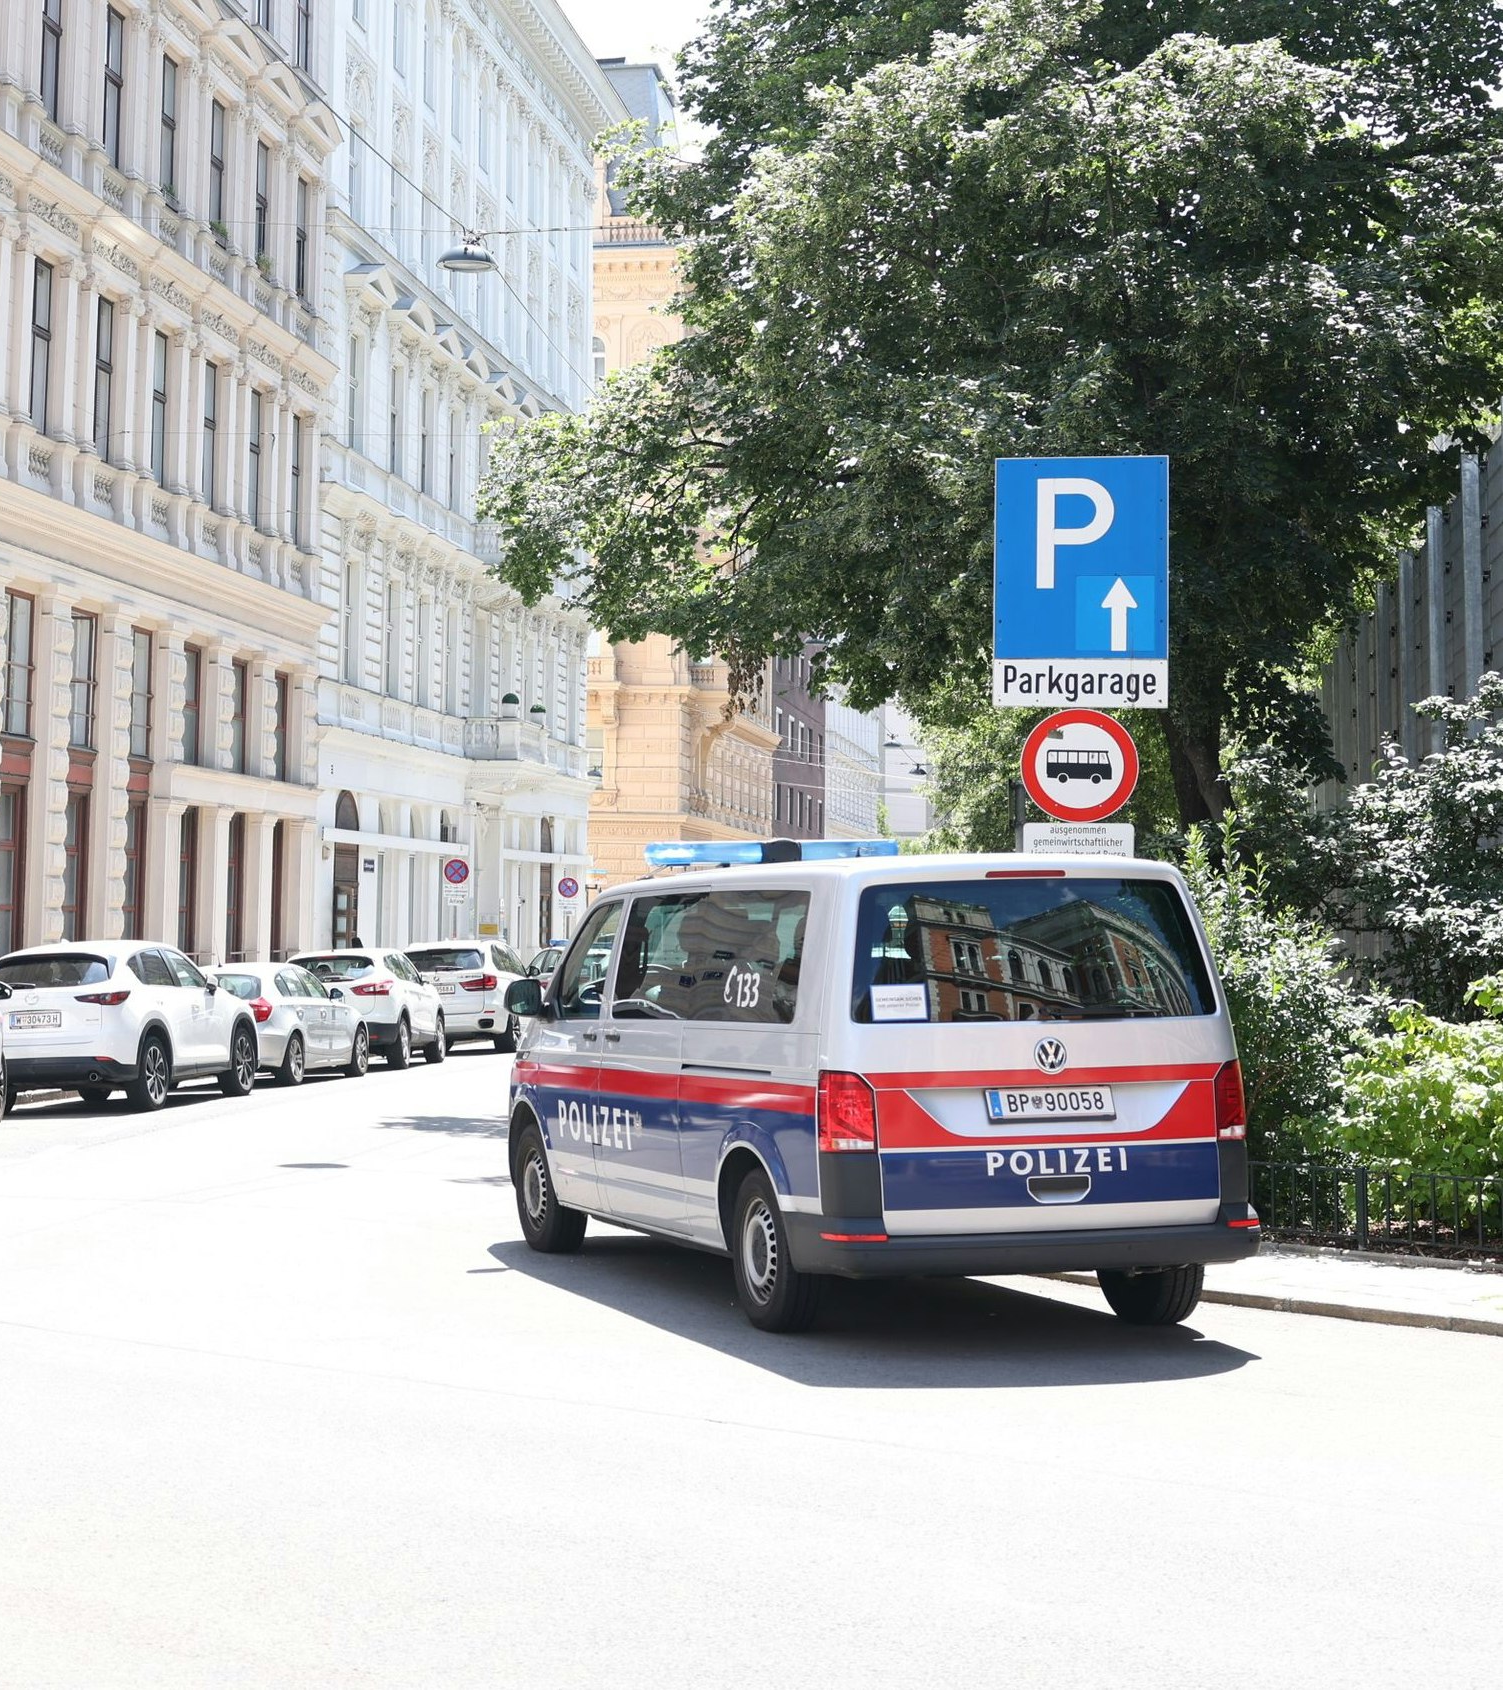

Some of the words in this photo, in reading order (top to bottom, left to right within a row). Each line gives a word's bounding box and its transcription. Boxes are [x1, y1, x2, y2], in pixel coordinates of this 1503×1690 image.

[1035, 477, 1115, 589] P
[1003, 665, 1157, 702] Parkgarage
[1033, 837, 1123, 848] gemeinwirtschaftlicher
[1049, 826, 1107, 836] ausgenommen
[736, 972, 761, 1008] 133
[1006, 1093, 1030, 1113] BP
[1044, 1091, 1105, 1112] 90058
[558, 1099, 633, 1151] POLIZEI
[985, 1147, 1128, 1177] POLIZEI
